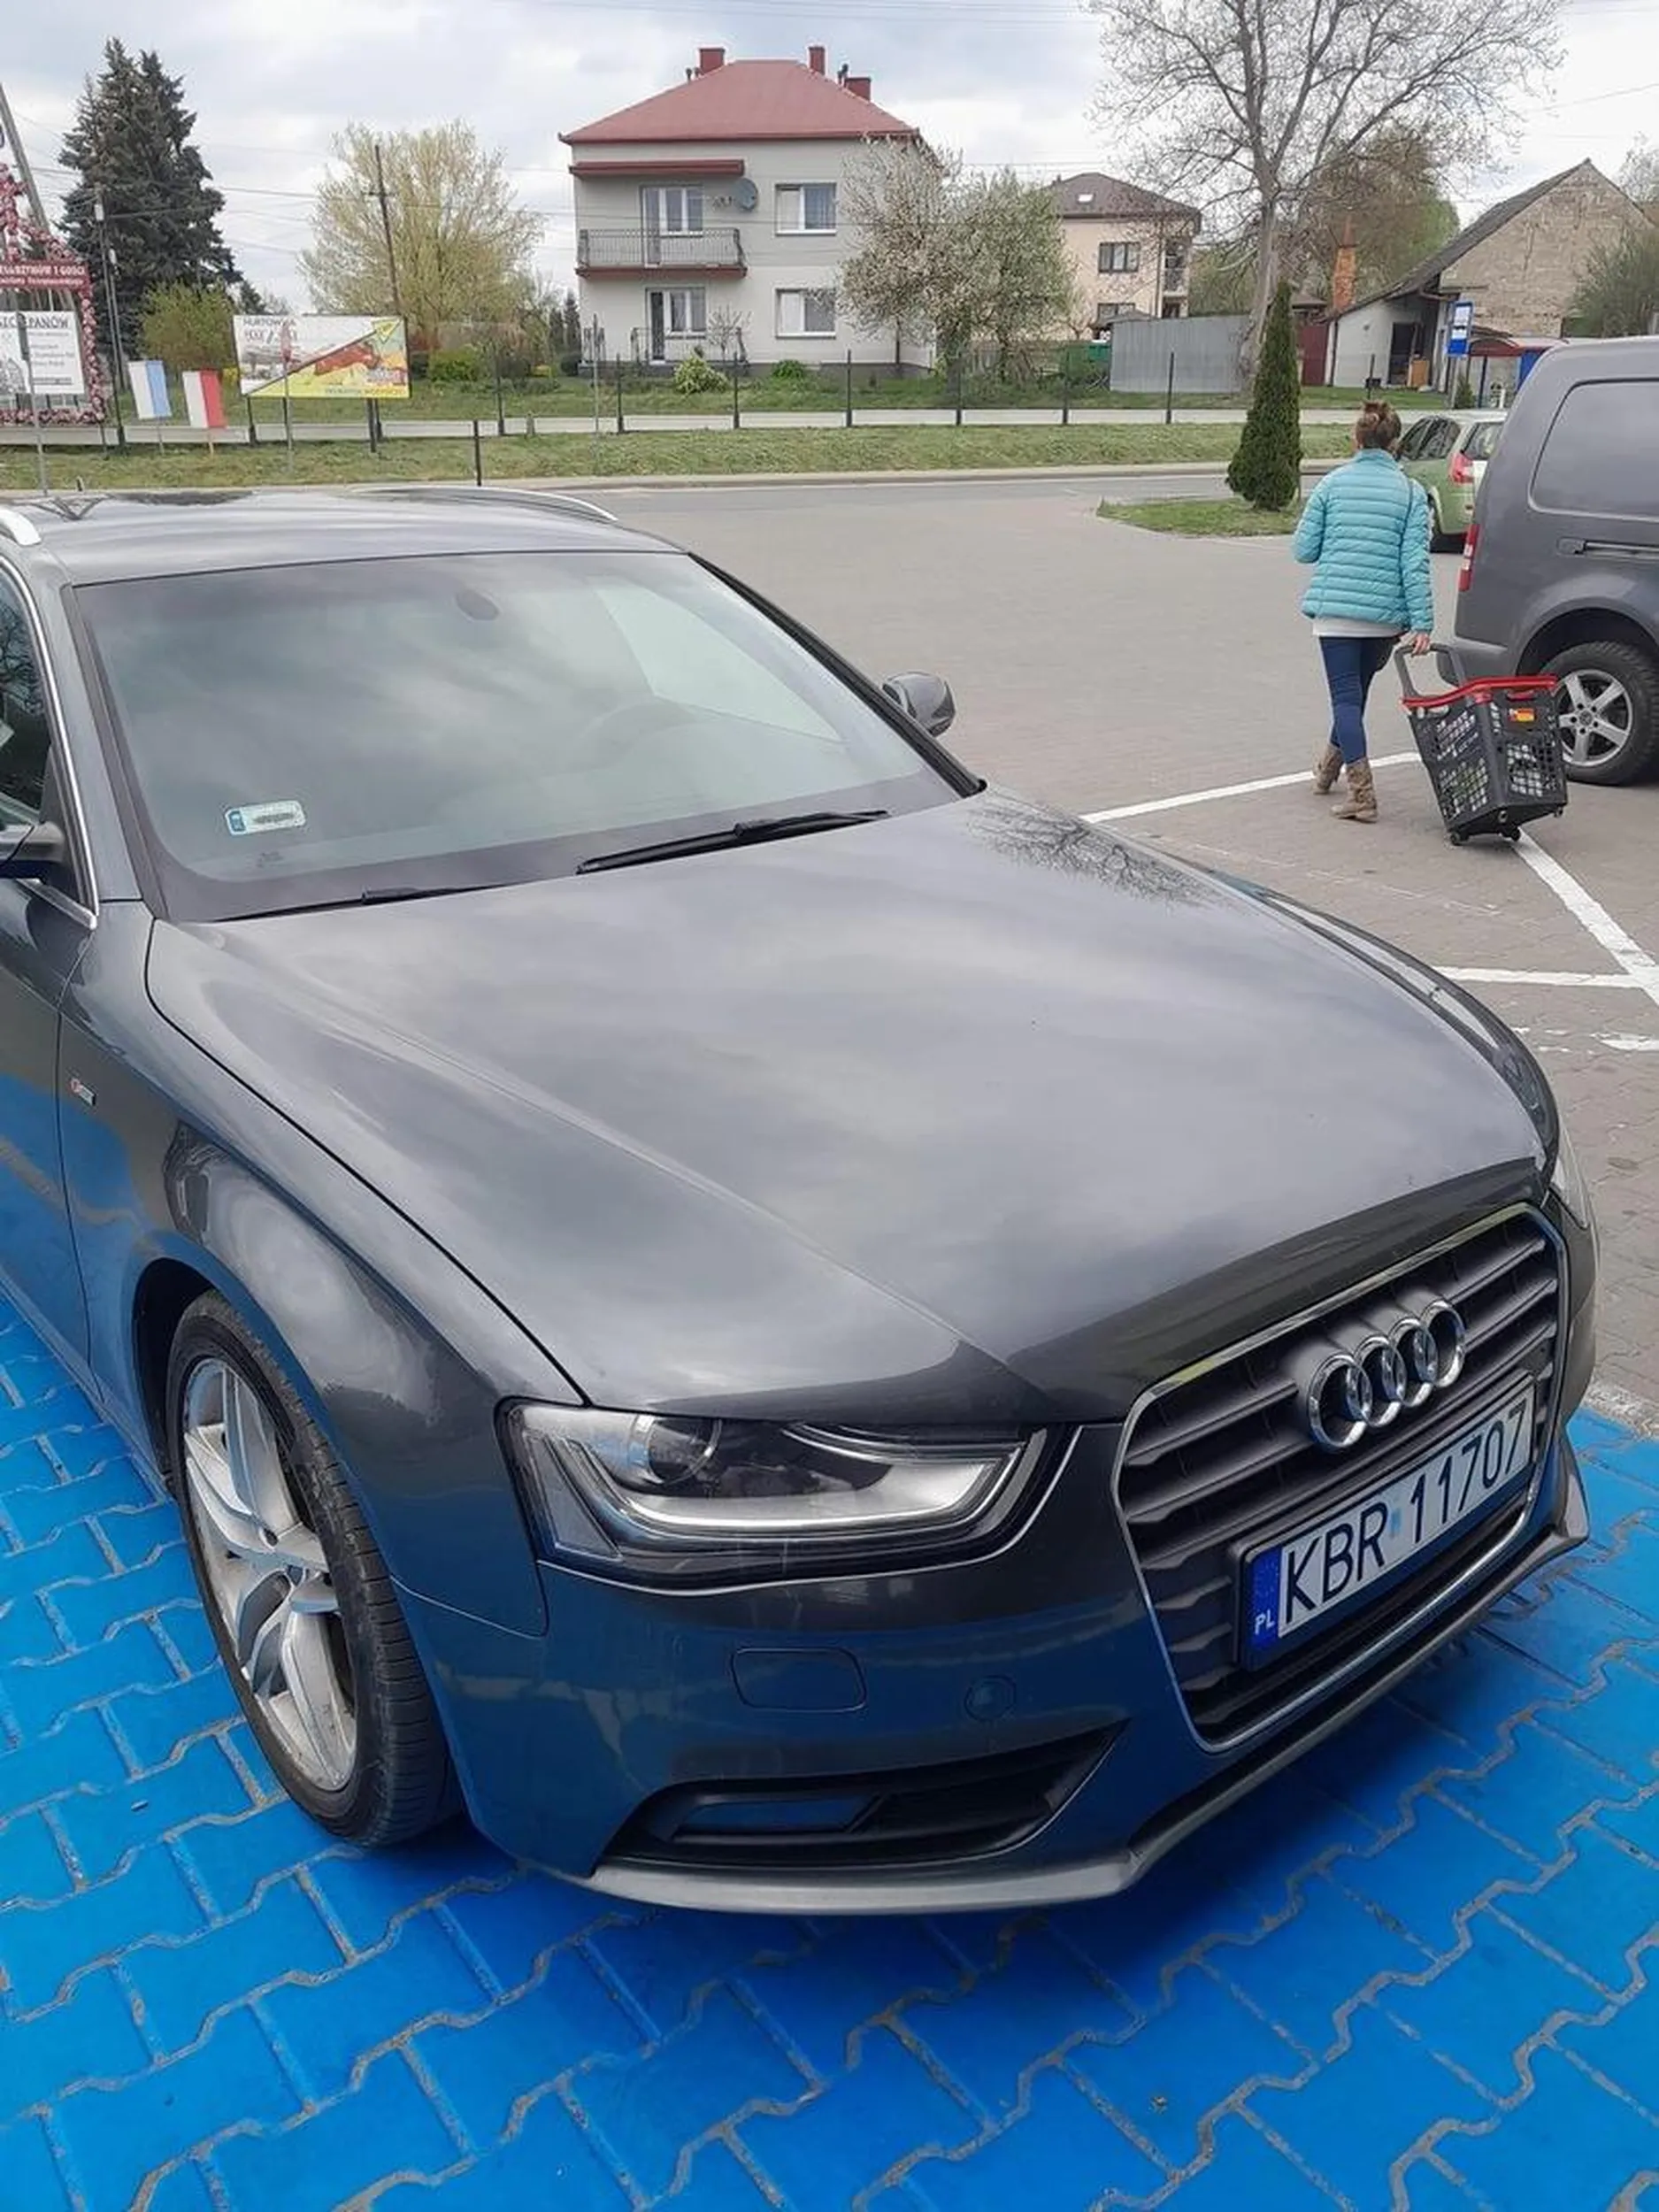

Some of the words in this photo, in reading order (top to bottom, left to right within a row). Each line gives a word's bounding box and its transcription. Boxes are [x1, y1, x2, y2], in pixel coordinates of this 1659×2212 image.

[1285, 1502, 1389, 1624] KBR
[1410, 1398, 1528, 1543] 11707
[1255, 1609, 1276, 1635] PL
